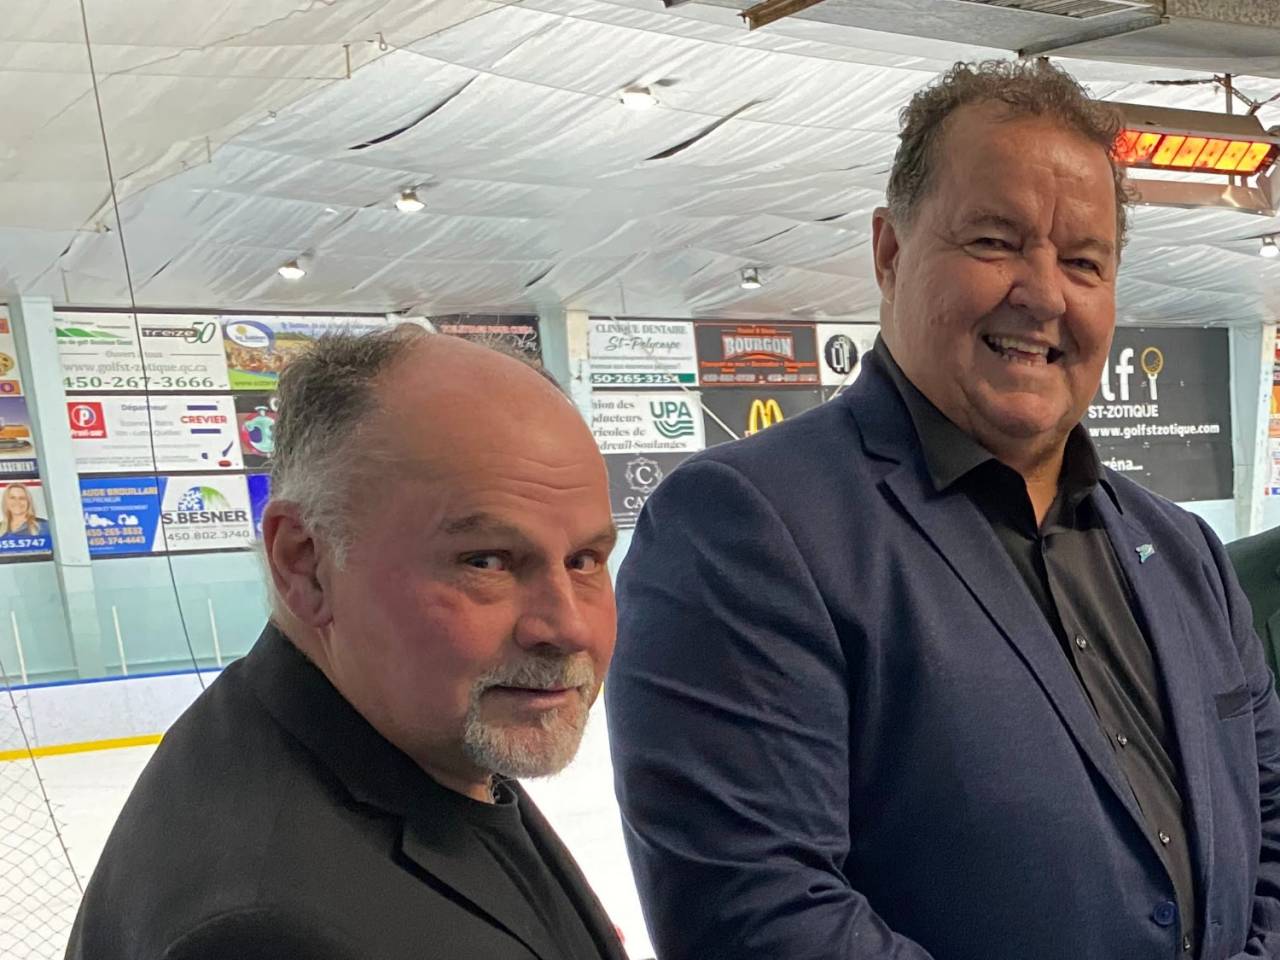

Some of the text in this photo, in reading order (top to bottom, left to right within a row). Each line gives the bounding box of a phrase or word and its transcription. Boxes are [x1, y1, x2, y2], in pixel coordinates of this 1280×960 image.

[595, 324, 688, 335] CLINIQUE DENTAIRE
[617, 400, 635, 409] des
[649, 401, 693, 418] UPA
[1088, 405, 1159, 418] ST-ZOTIQUE
[180, 415, 228, 424] CREVIER
[1089, 422, 1220, 439] www.golfstzotique.com
[600, 440, 687, 450] dreuil-Soulanges
[162, 511, 248, 525] S.BESNER
[0, 538, 46, 548] 55.5747
